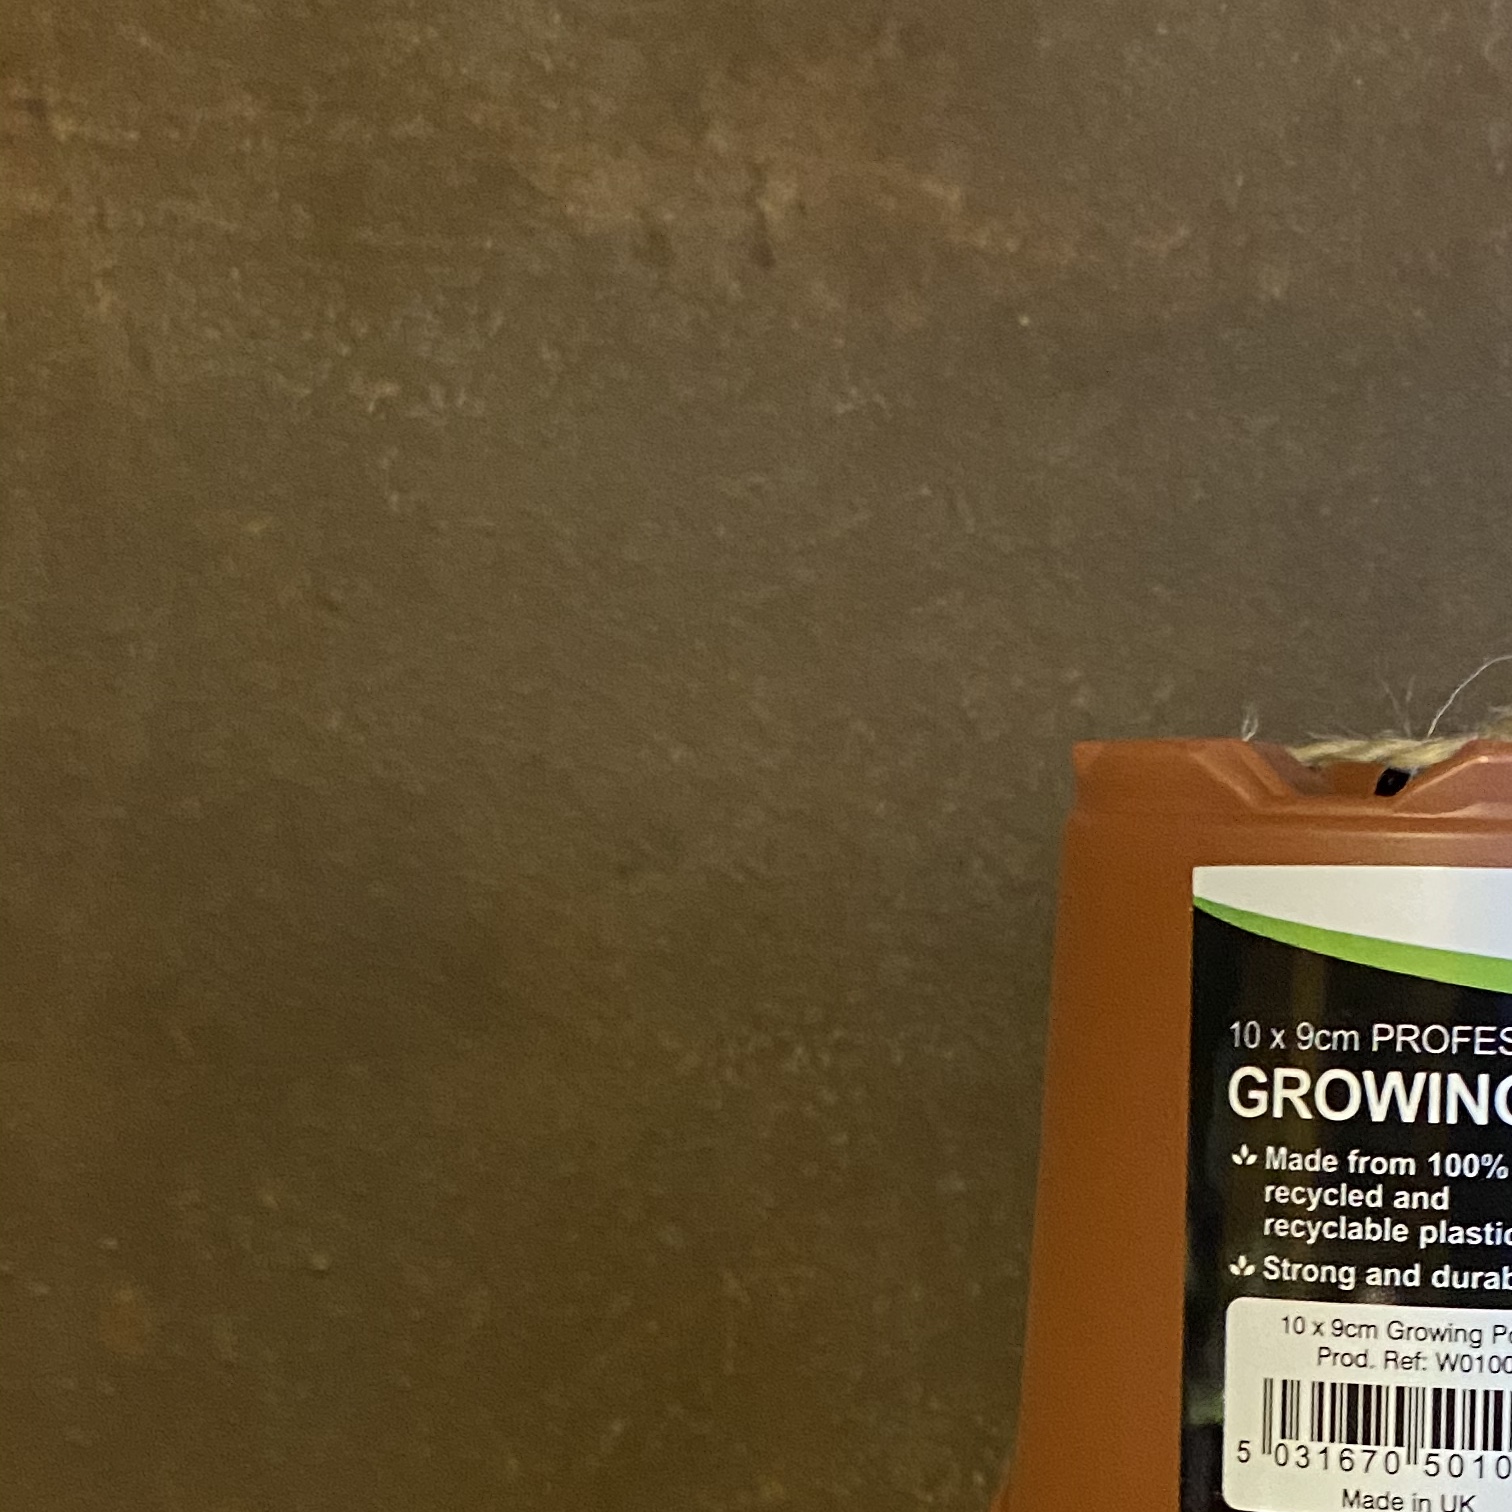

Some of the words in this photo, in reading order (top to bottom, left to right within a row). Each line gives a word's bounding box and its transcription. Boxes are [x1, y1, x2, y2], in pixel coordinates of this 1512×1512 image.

[1229, 1021, 1260, 1050] 10
[1269, 1029, 1286, 1050] x
[1295, 1022, 1360, 1053] 9cm
[1264, 1146, 1338, 1174] Made
[1347, 1150, 1416, 1177] from
[1427, 1152, 1509, 1180] 100%
[1264, 1182, 1383, 1212] recycled
[1393, 1185, 1450, 1211] and
[1263, 1215, 1409, 1245] recyclable
[1262, 1255, 1356, 1291] Strong
[1365, 1261, 1421, 1288] and
[1282, 1316, 1305, 1336] 10
[1312, 1321, 1325, 1336] x
[1332, 1318, 1378, 1340] 9cm
[1387, 1320, 1483, 1348] Growing
[1317, 1347, 1375, 1369] Prod.
[1385, 1350, 1427, 1372] Ref:
[1237, 1440, 1251, 1463] 5
[1274, 1443, 1400, 1475] 031670
[1342, 1488, 1404, 1512] Made
[1412, 1492, 1431, 1512] in
